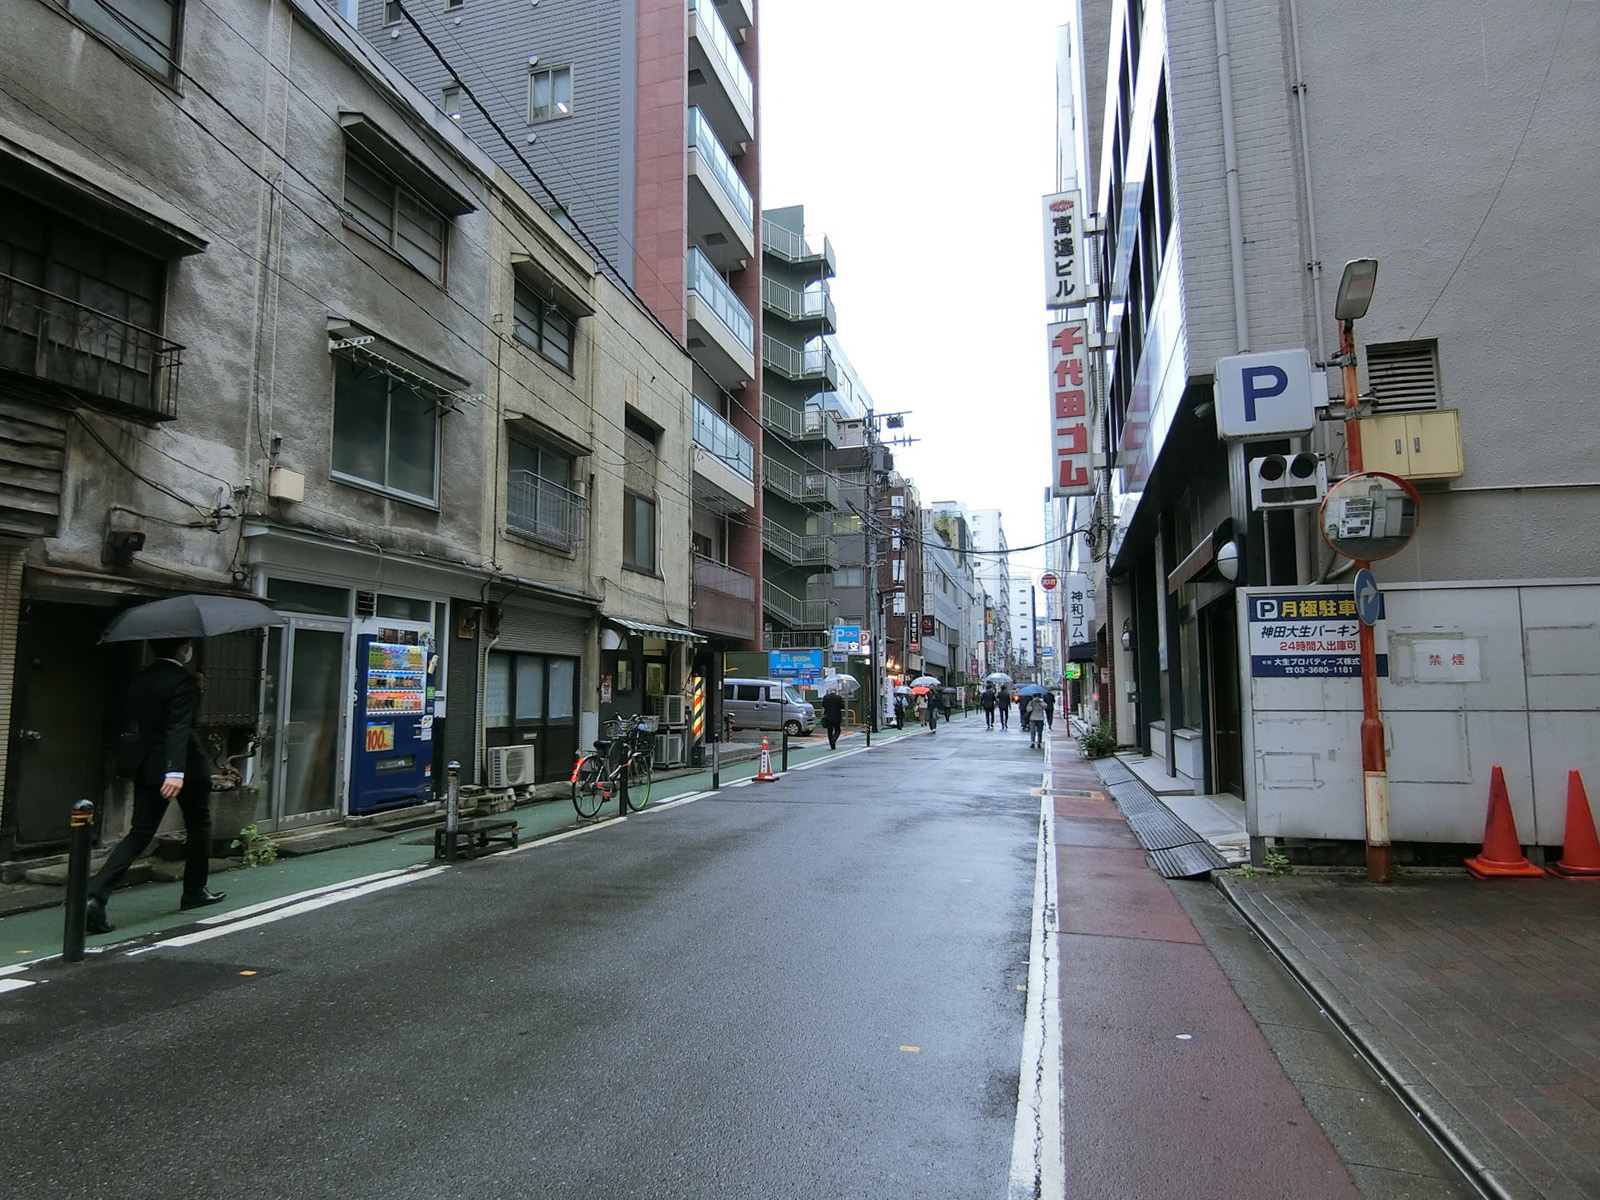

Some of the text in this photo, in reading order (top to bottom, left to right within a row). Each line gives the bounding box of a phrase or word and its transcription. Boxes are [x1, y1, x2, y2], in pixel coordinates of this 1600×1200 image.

[1241, 365, 1288, 422] P
[1052, 326, 1089, 487] 千代田ゴム
[1070, 590, 1084, 638] 神和ゴム
[1260, 602, 1275, 617] P
[1281, 600, 1357, 618] 月極駐車
[1261, 625, 1360, 638] 神田大生パーキン
[1279, 640, 1357, 651] 24時間入出庫可
[1274, 658, 1361, 666] 大生プロパティーズ株式
[1428, 654, 1465, 666] 禁煙
[1295, 666, 1353, 674] 03-3680-1181
[367, 729, 385, 751] 100
